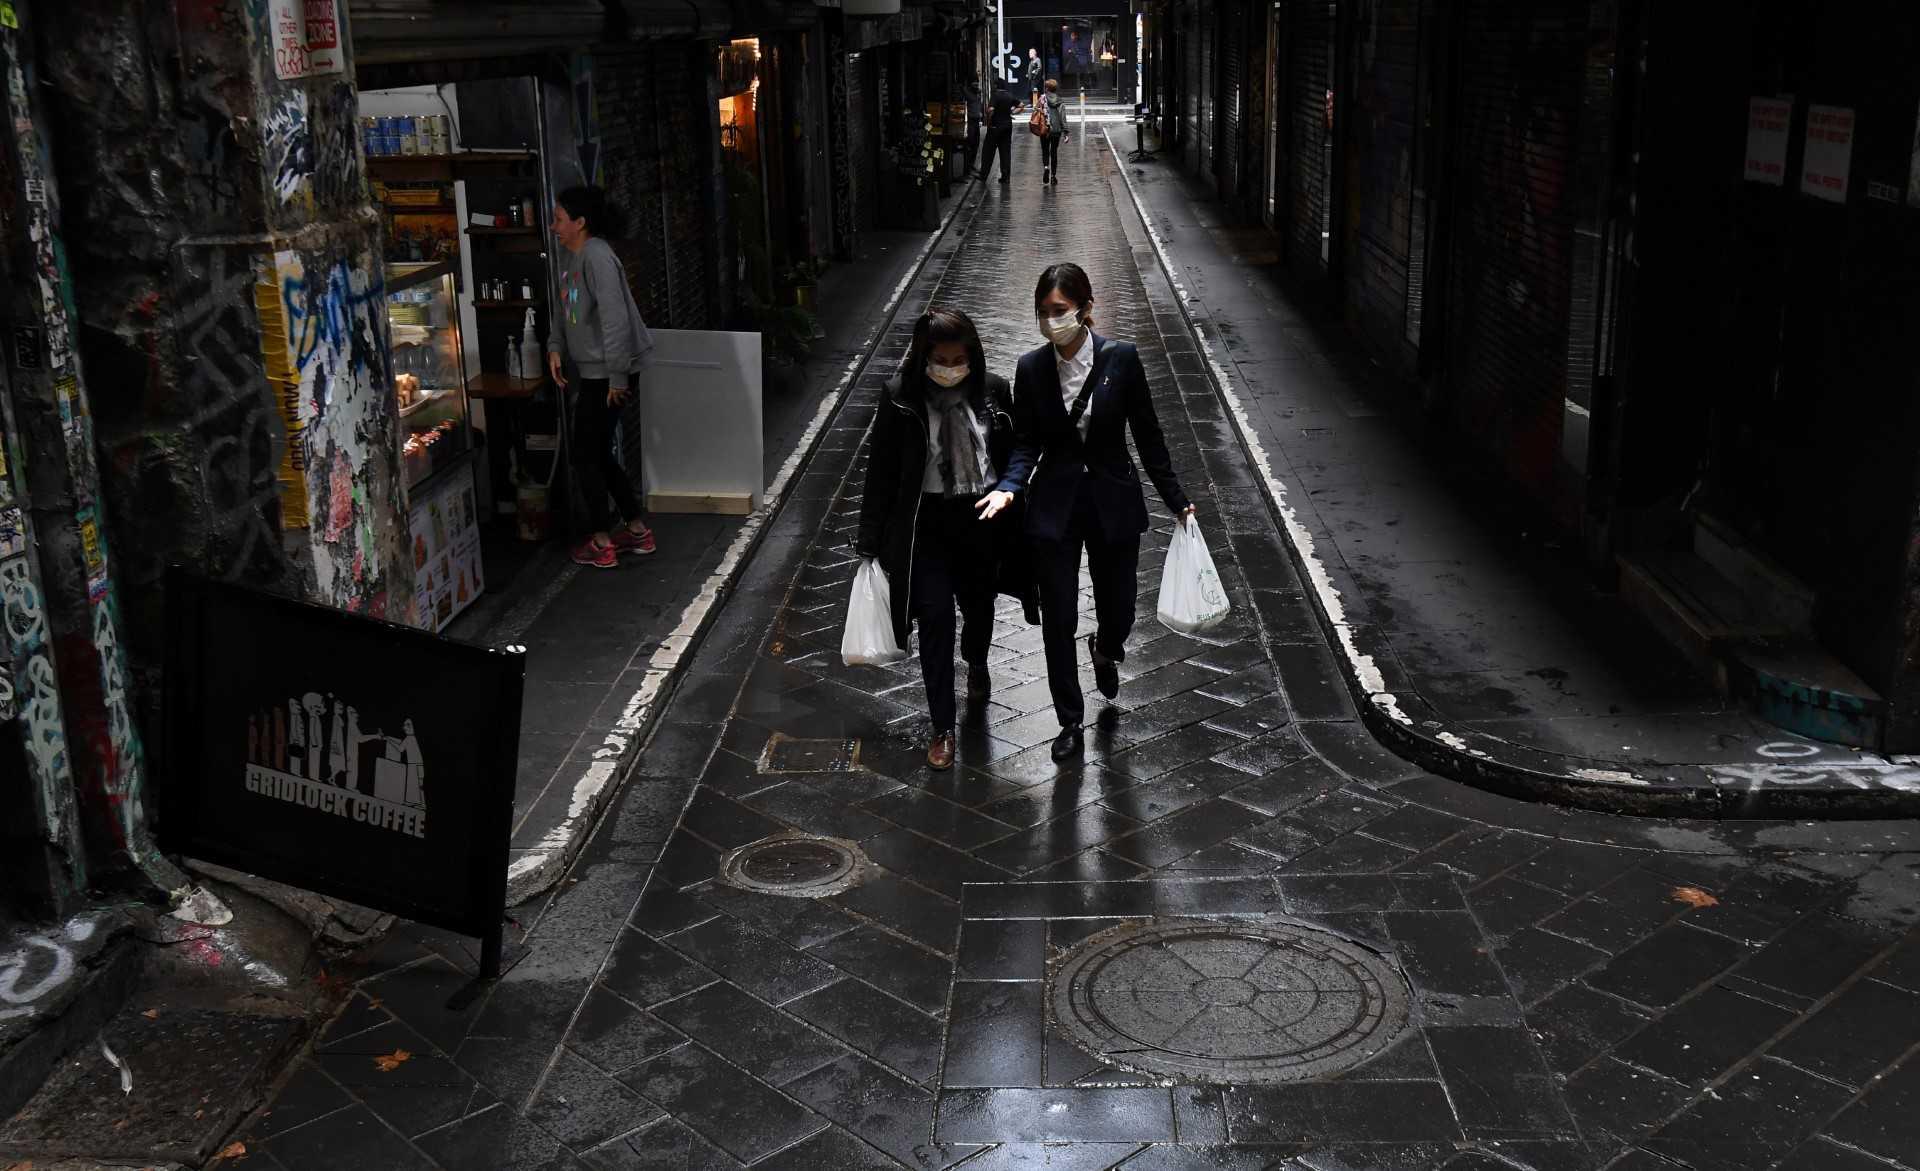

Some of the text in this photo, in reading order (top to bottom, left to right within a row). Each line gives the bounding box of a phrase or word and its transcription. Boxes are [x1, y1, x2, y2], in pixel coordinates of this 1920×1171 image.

[307, 22, 335, 42] ZONE
[246, 764, 425, 838] GRIDLOCK COFFEE
